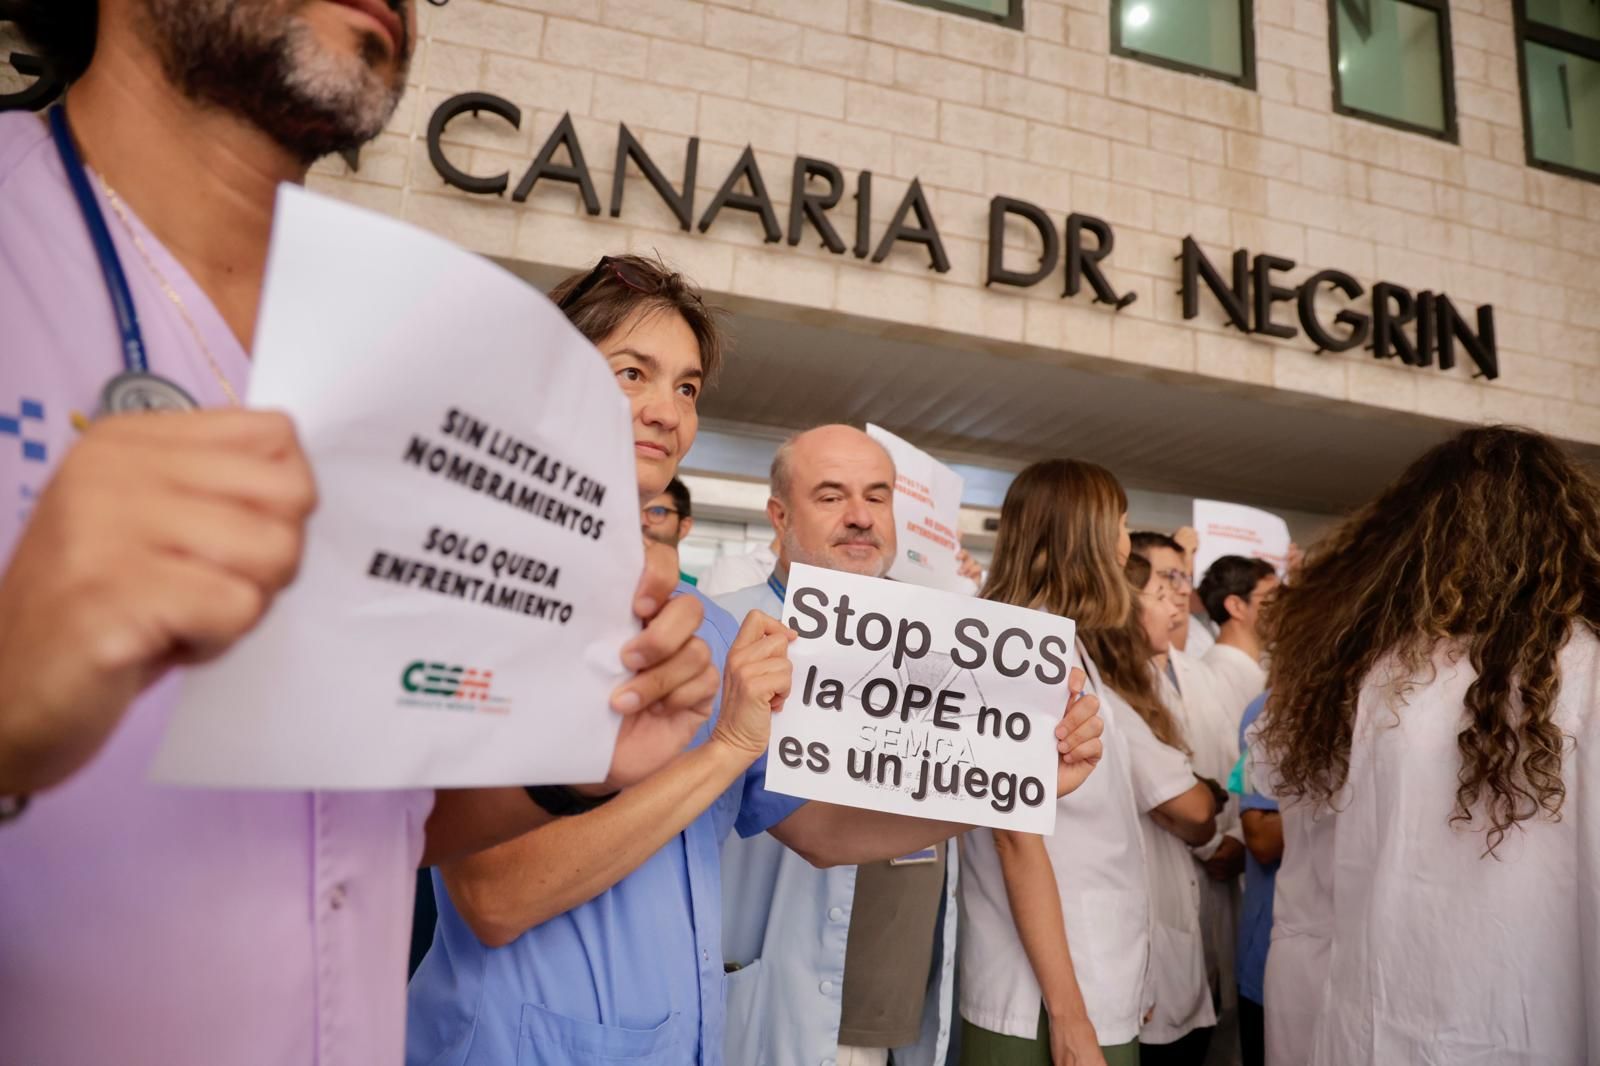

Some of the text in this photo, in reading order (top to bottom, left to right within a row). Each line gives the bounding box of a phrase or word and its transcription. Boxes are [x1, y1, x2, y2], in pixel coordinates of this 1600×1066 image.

[427, 91, 1499, 380] CANARIA DR. NEGRIN
[403, 436, 605, 541] NOMBRAMIENTOS
[441, 408, 607, 507] SIN LISTAS Y SIN
[367, 550, 573, 624] ENFRENTAMIENTO
[424, 526, 560, 588] SOLO QUEDA
[788, 587, 1067, 685] Stop SCS
[802, 665, 1031, 741] la OPE no
[779, 736, 830, 773] es
[847, 747, 902, 786] un
[911, 750, 1045, 812] juego
